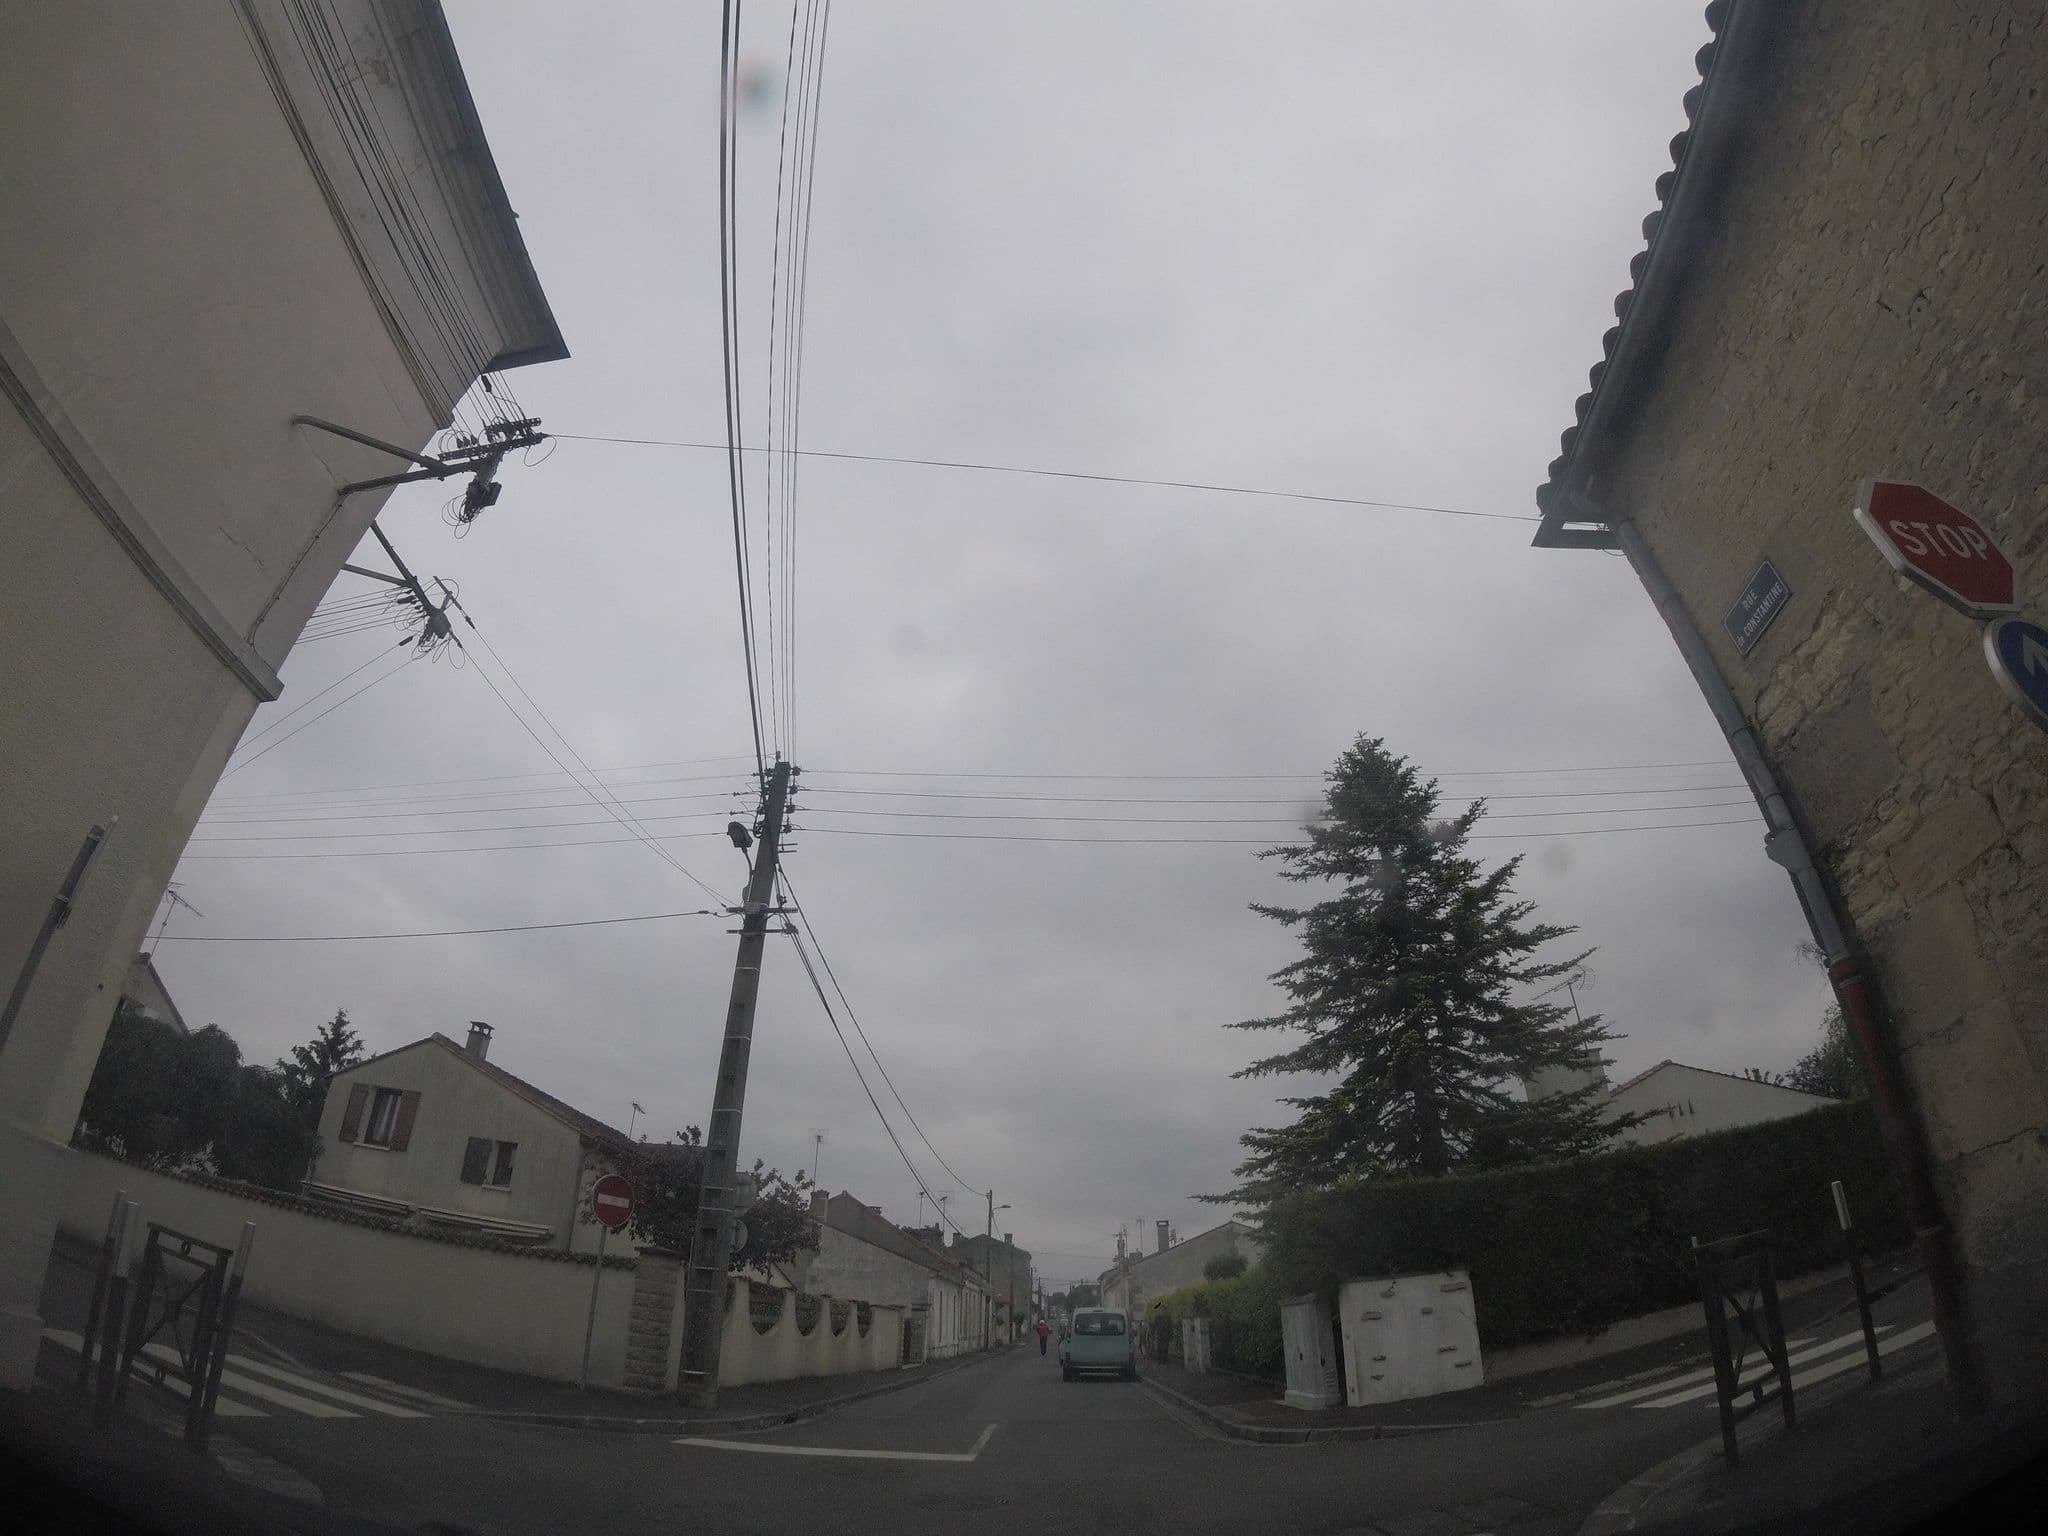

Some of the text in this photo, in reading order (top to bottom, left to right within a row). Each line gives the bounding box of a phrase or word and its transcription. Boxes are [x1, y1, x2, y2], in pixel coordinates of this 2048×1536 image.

[1889, 520, 1988, 560] STOP
[1742, 589, 1758, 611] RUE
[1743, 582, 1784, 636] CONSTANTINE
